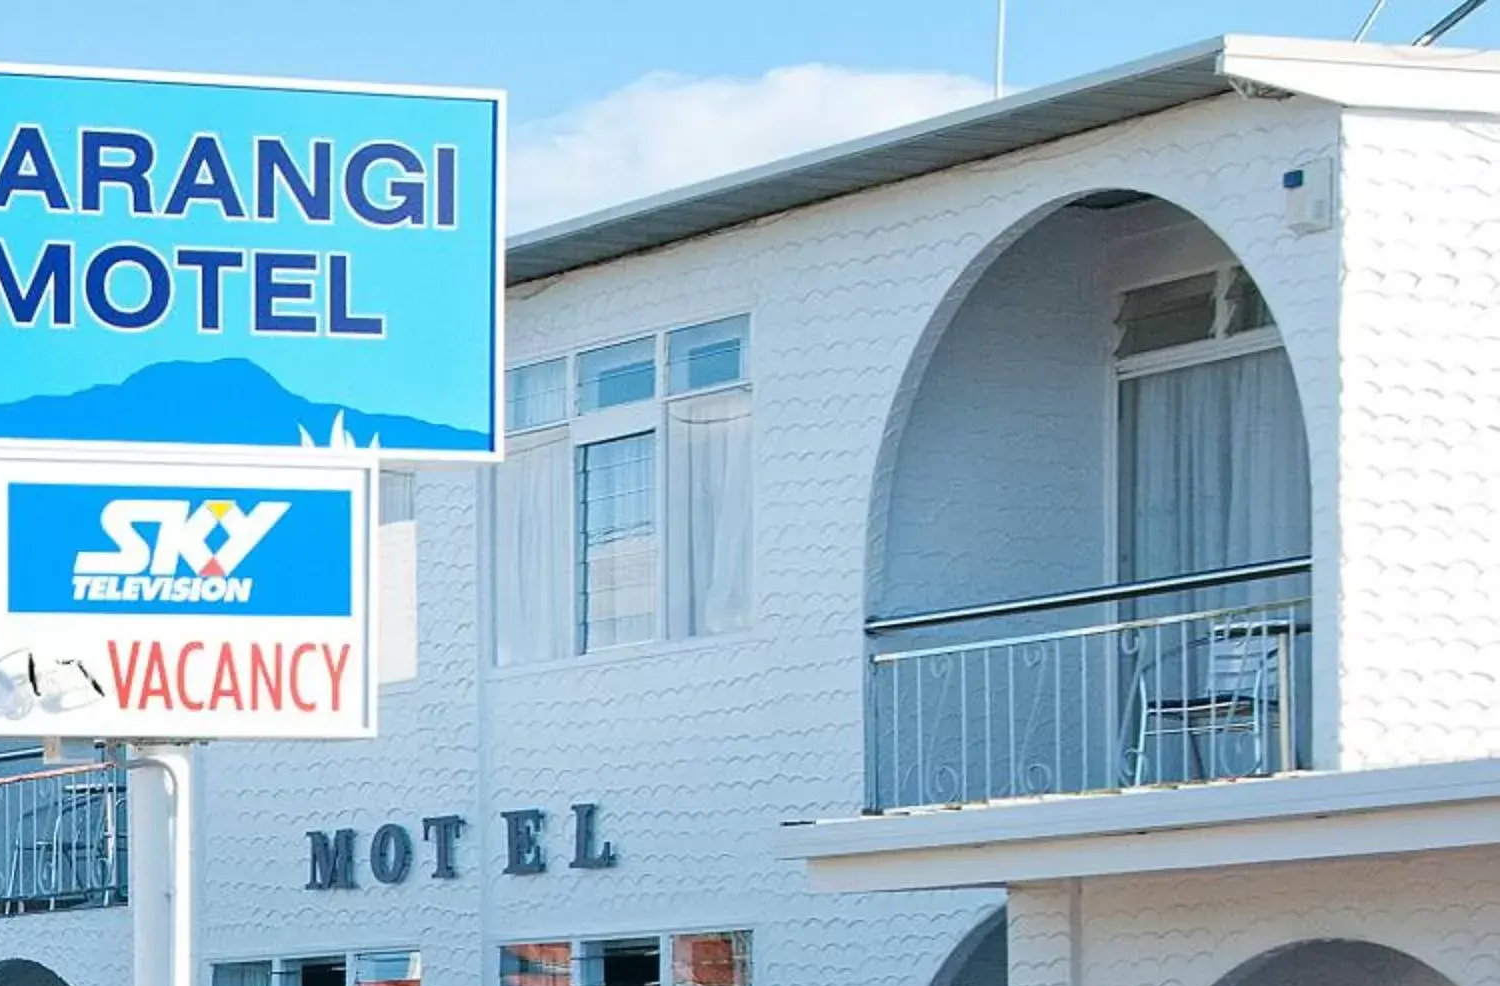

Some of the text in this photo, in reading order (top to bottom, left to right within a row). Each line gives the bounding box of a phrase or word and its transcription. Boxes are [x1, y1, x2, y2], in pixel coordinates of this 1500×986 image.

[72, 499, 292, 576] SKY
[71, 575, 253, 603] TELEVISION
[106, 639, 352, 712] VACANCY
[305, 803, 618, 890] MOTEL
